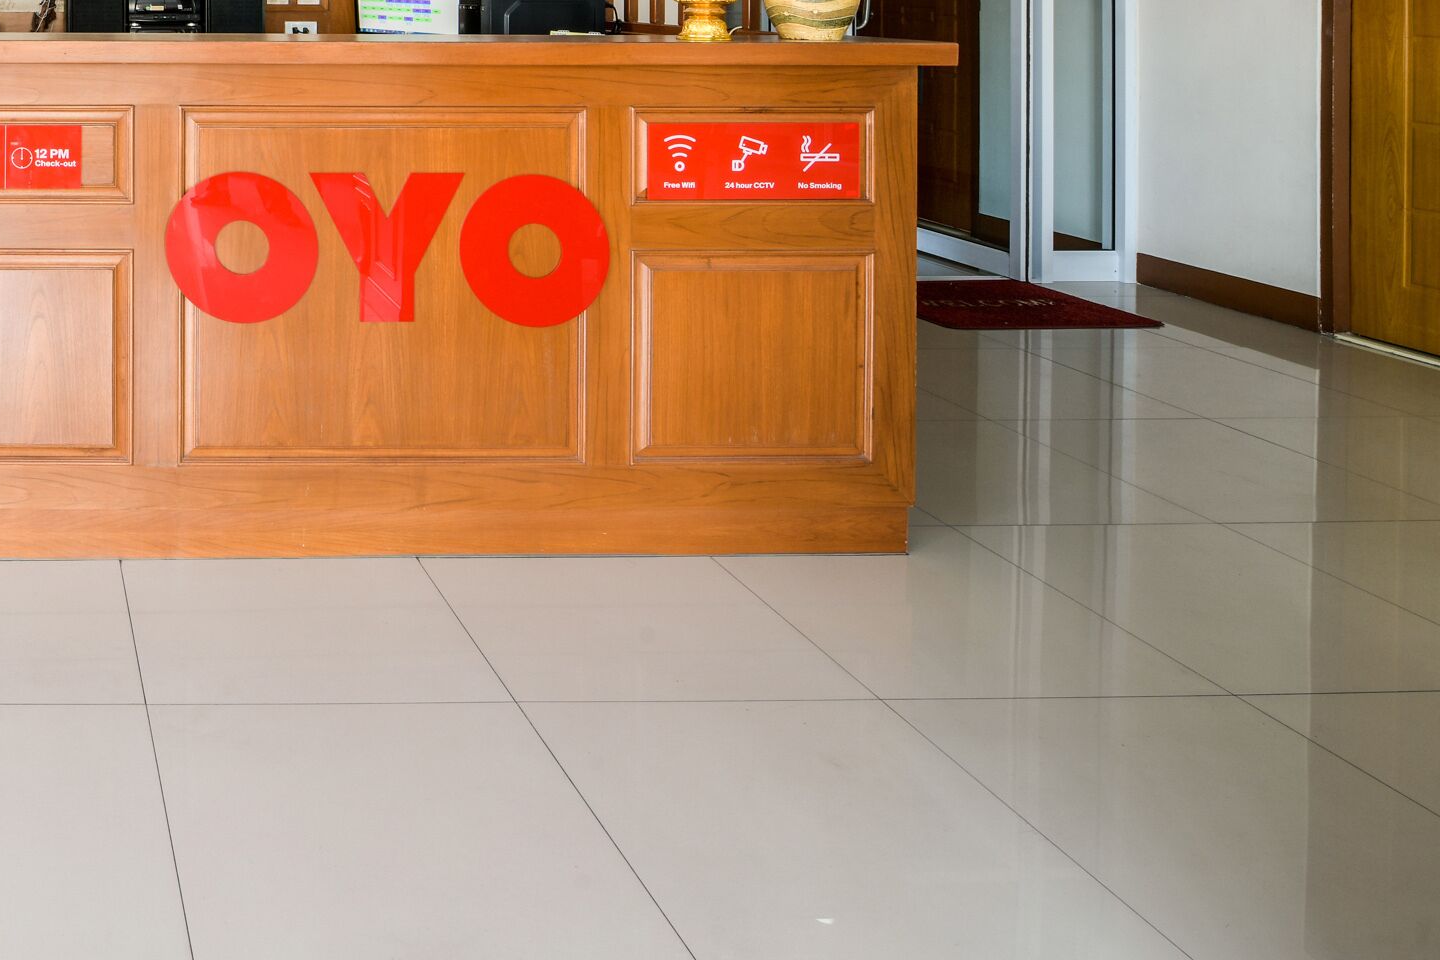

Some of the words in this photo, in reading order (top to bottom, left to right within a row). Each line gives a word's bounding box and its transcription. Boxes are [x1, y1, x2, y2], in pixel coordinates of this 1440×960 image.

[35, 149, 48, 159] 12
[50, 149, 69, 159] PM
[736, 181, 753, 189] hour
[810, 182, 842, 190] Smoking
[164, 170, 611, 328] OYO
